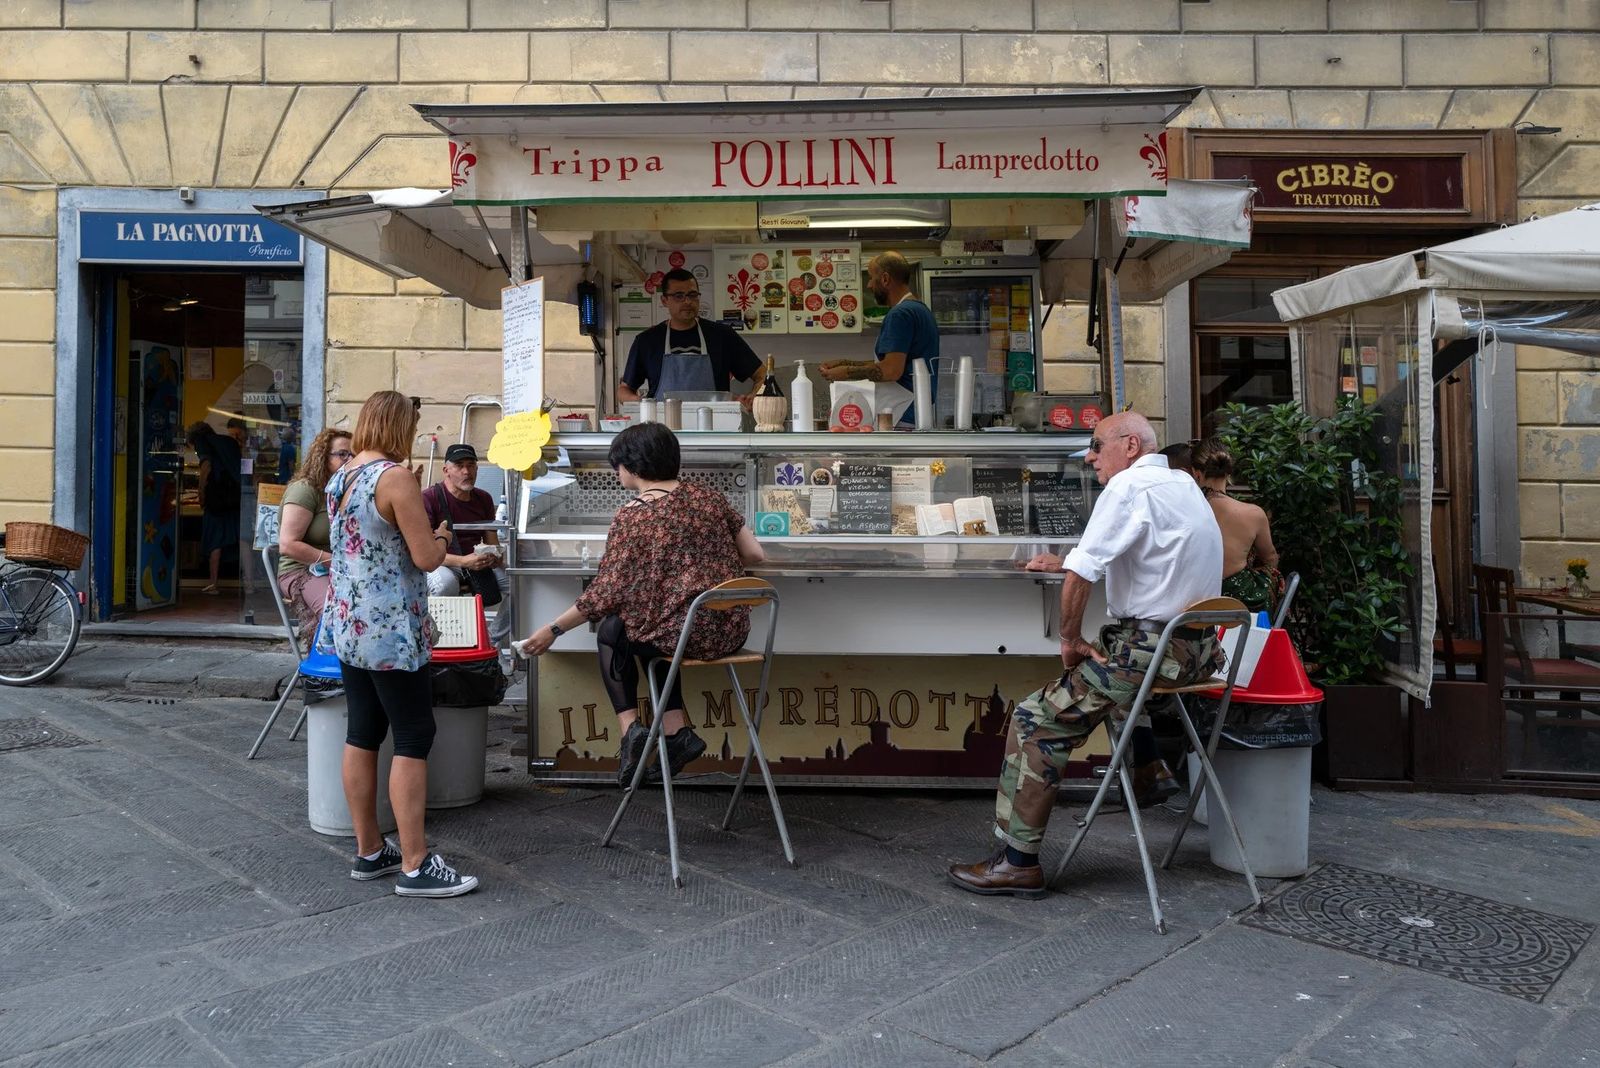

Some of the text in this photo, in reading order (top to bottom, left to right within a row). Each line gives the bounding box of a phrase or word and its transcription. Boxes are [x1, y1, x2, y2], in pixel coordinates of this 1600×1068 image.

[523, 136, 1099, 188] Trippa POLLINI Lampredotto
[1276, 161, 1395, 194] CIBRÈO
[1292, 193, 1381, 206] TRATTORIA
[116, 222, 264, 243] LA PAGNOTTA
[248, 244, 292, 259] Panificio
[559, 703, 608, 745] IL
